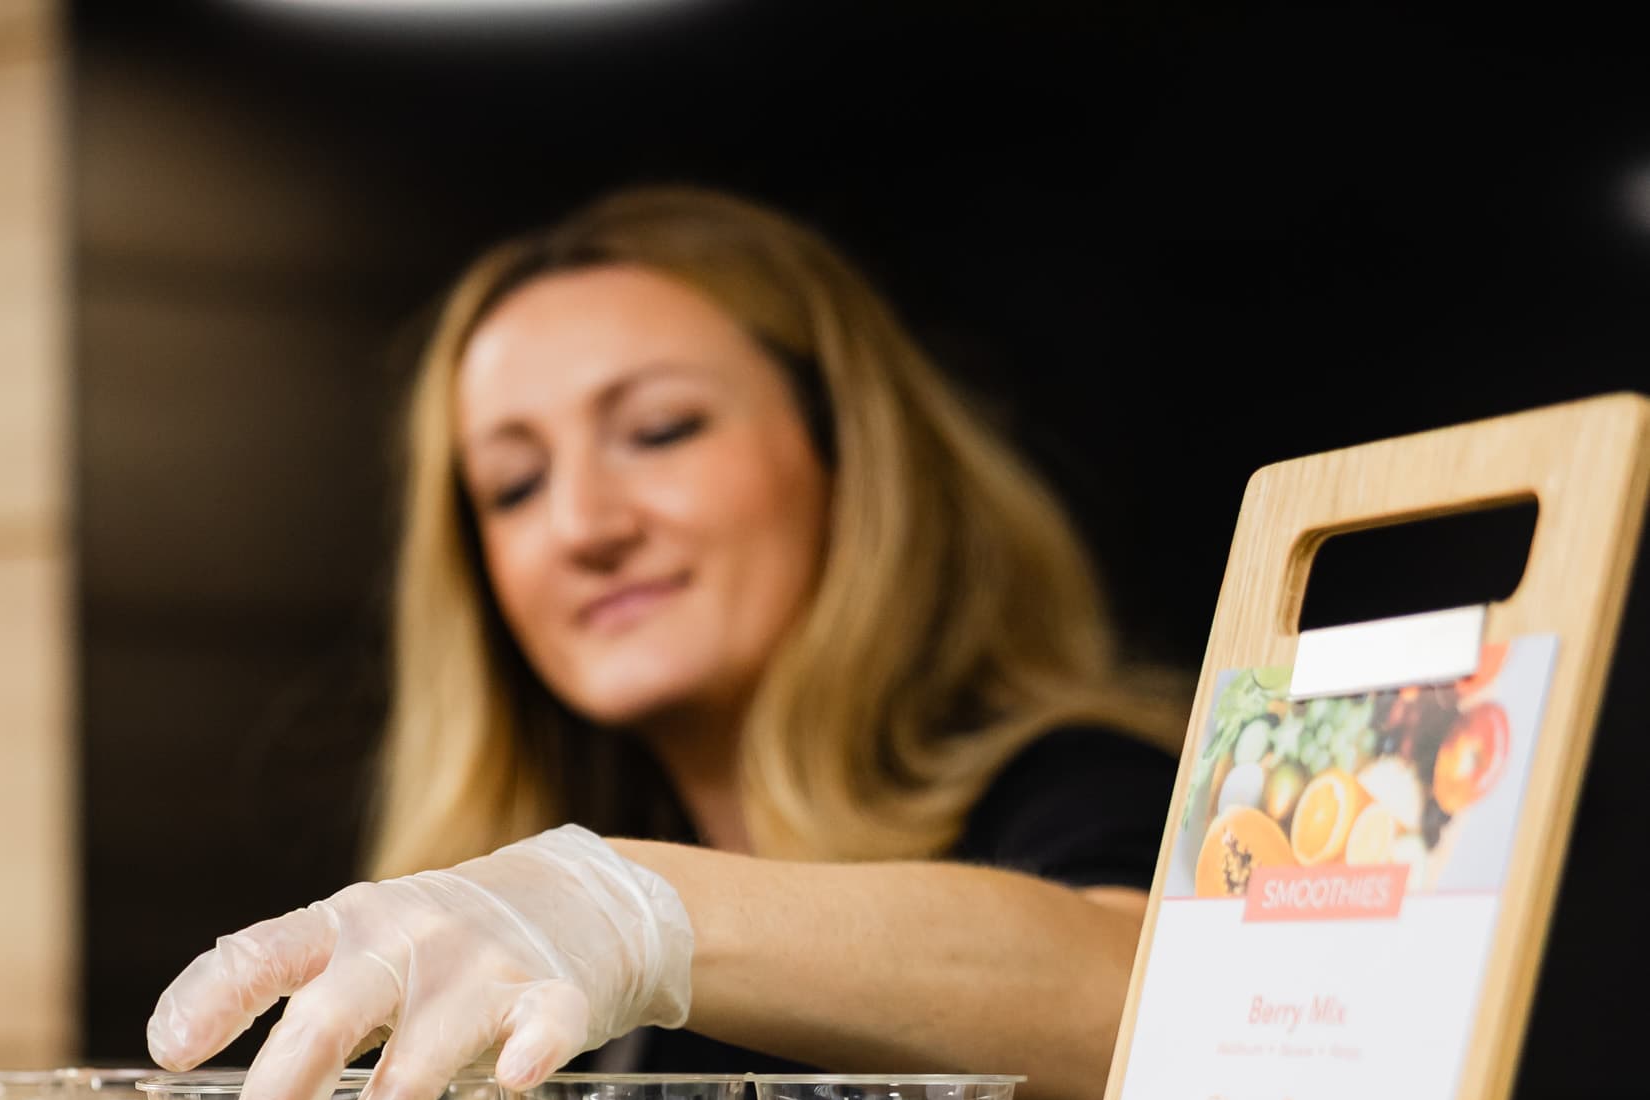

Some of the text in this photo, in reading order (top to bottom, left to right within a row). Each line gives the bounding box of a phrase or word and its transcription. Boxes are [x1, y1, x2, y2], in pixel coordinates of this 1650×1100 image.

[1262, 875, 1391, 909] SMOOTHIES
[1248, 994, 1347, 1034] Berry Mix
